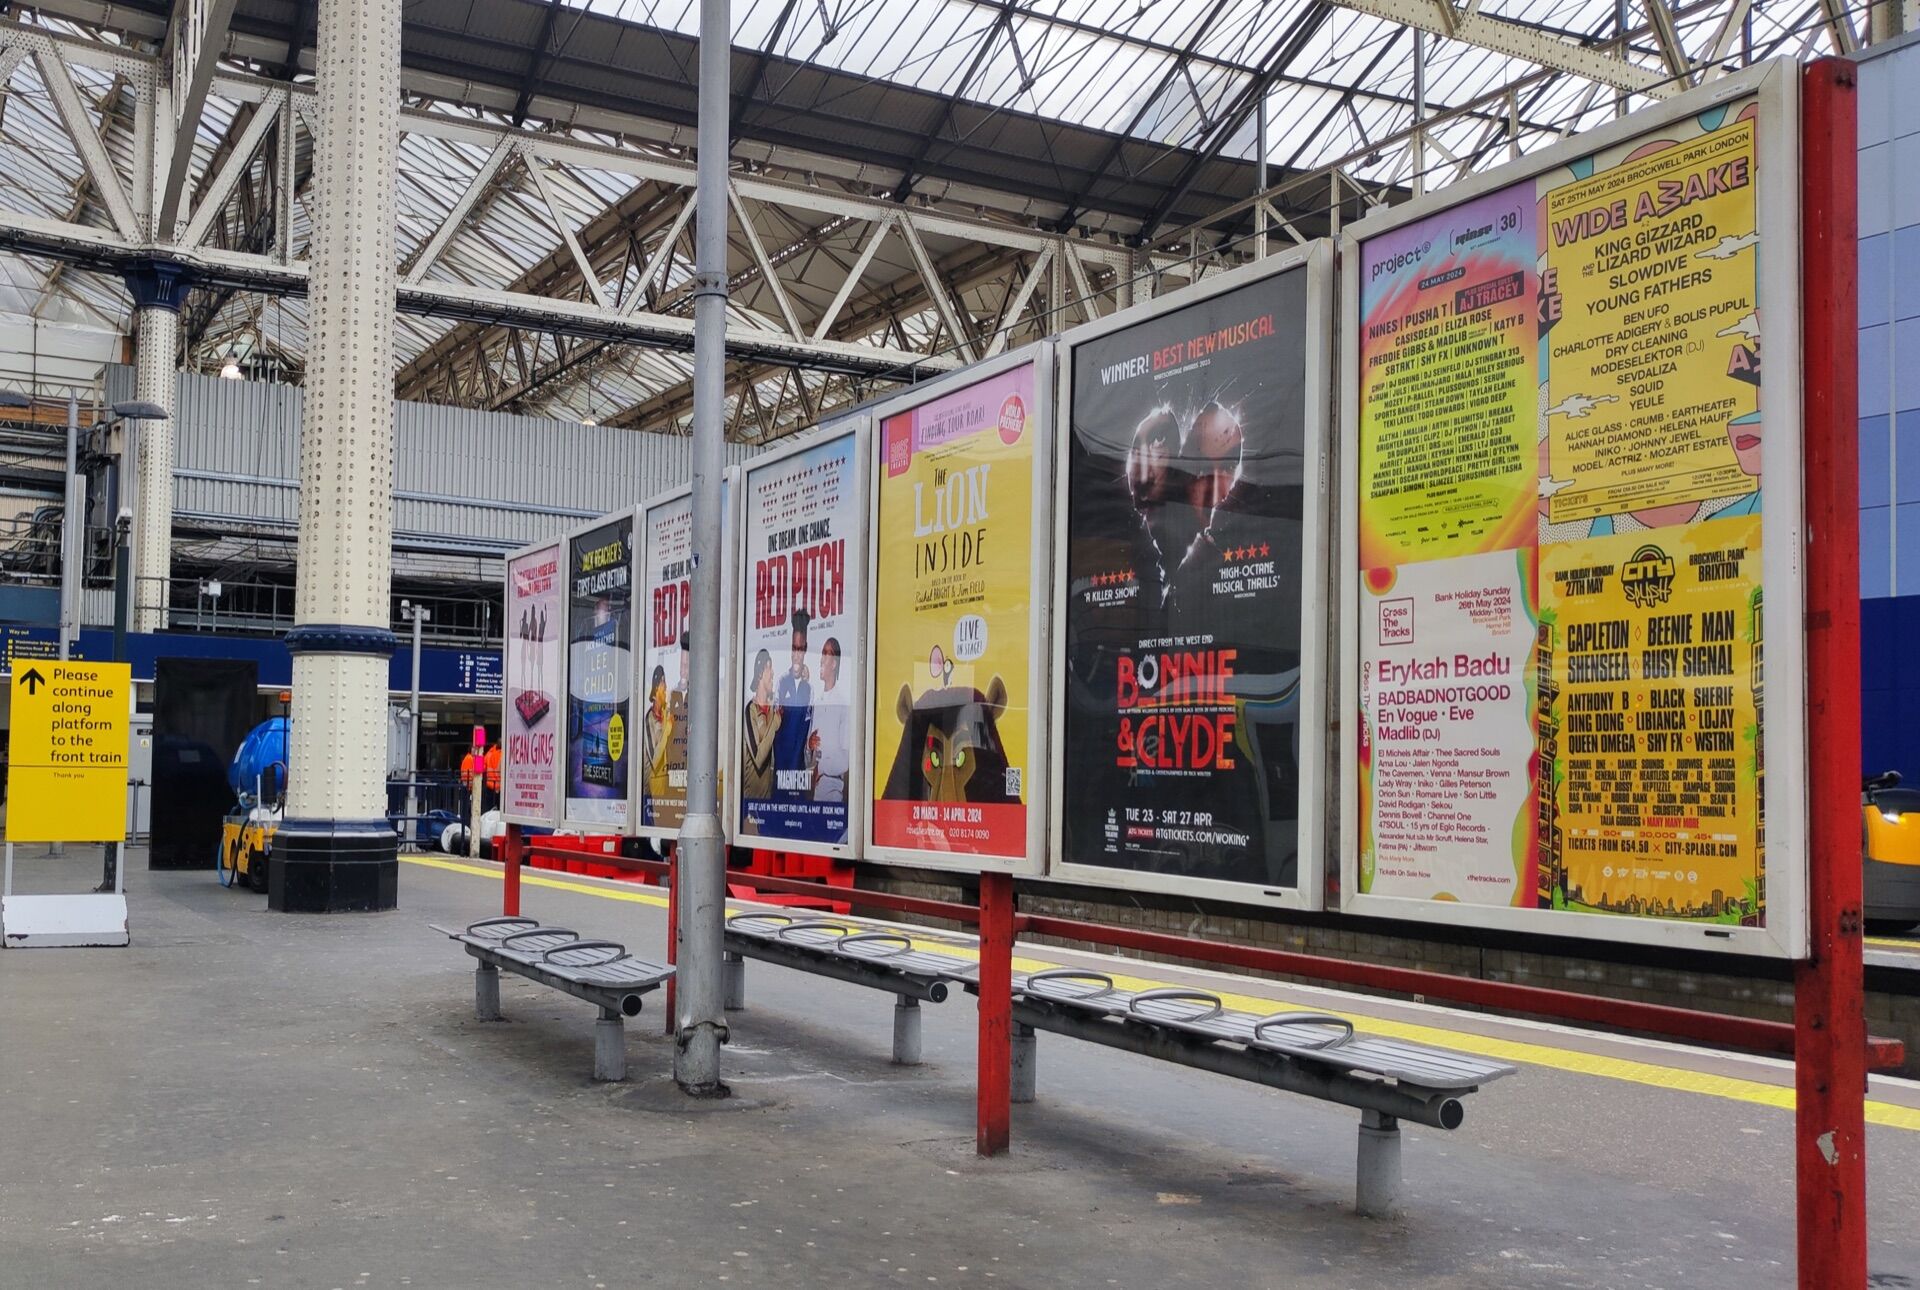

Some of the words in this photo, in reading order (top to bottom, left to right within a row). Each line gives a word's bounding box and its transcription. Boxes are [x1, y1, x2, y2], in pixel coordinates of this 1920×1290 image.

[1551, 199, 1566, 209] SAT
[1567, 192, 1587, 205] 25TH
[1588, 184, 1606, 198] MAY
[1607, 177, 1626, 190] 2024
[1627, 158, 1682, 186] BROCKWELL
[1683, 147, 1708, 164] PARK
[1709, 131, 1750, 153] LONDON
[1500, 212, 1517, 232] 30
[1551, 199, 1627, 248] WIDE
[1594, 236, 1631, 259] KING
[1635, 214, 1703, 245] GIZZARD
[1597, 246, 1650, 274] LIZARD
[1656, 225, 1717, 256] WIZARD
[1420, 280, 1430, 289] 24
[1431, 275, 1445, 286] MAY
[1446, 269, 1463, 282] 2024
[1609, 255, 1687, 290] SLOWDIVE
[1586, 289, 1640, 315] YOUNG
[1644, 268, 1712, 300] FATHERS
[1369, 320, 1398, 339] NINES
[1405, 307, 1439, 329] PUSHA
[1441, 304, 1448, 317] T
[1459, 295, 1473, 312] AJ
[1477, 281, 1519, 308] TRACEY
[1623, 310, 1645, 326] BEN
[1647, 304, 1670, 320] UFO
[1395, 325, 1439, 347] CASISDEAD
[1445, 315, 1468, 332] ELIZA
[1470, 309, 1492, 326] ROSE
[1553, 333, 1614, 358] CHARLOTTE
[1616, 320, 1662, 344] ADIGERY
[1674, 308, 1707, 328] BOLIS
[1709, 298, 1750, 317] PUPUL
[1101, 354, 1150, 386] WINNER!
[1153, 343, 1184, 370] BEST
[1188, 332, 1216, 360] NEW
[1218, 314, 1276, 350] MUSICAL
[1369, 351, 1401, 368] FREDDIE
[1402, 343, 1427, 358] GIBBS
[1428, 340, 1435, 350] &
[1436, 331, 1468, 349] MADLIB
[1494, 316, 1517, 332] KATY
[1518, 313, 1525, 325] B
[1605, 344, 1628, 359] DRY
[1631, 329, 1688, 351] CLEANING
[1385, 359, 1415, 376] SBTRKT
[1420, 353, 1436, 367] SHY
[1438, 350, 1449, 362] FX
[1454, 336, 1498, 358] UNKNOWN
[1500, 334, 1505, 345] T
[1591, 345, 1683, 377] MODESELEKTOR
[1617, 362, 1677, 385] SEVDALIZA
[1630, 380, 1664, 397] SQUID
[1005, 404, 1021, 418] WORLD
[1629, 393, 1665, 411] YEULE
[921, 423, 946, 444] FINDING
[947, 415, 964, 435] YOUR
[966, 405, 985, 426] ROAR!
[1000, 416, 1023, 433] PREMIERE
[934, 468, 947, 488] THE
[913, 463, 991, 537] LION
[767, 533, 778, 554] ONE
[798, 524, 809, 545] ONE
[809, 518, 832, 542] CHANCE.
[915, 528, 987, 579] INSIDE
[1622, 556, 1675, 583] CITY
[1698, 561, 1739, 583] BRIXTON
[577, 576, 590, 598] FIRST
[590, 571, 607, 594] CLASS
[606, 565, 628, 589] RETURN
[755, 555, 788, 630] RED
[791, 538, 845, 621] PITCH
[1212, 580, 1244, 595] MUSICAL
[1566, 578, 1585, 597] 27TH
[1586, 577, 1604, 594] MAY
[1092, 588, 1113, 602] KILLER
[1435, 593, 1453, 602] Bank
[1454, 589, 1482, 600] Holiday
[1482, 586, 1511, 597] Sunday
[1458, 600, 1475, 610] 26th
[1475, 598, 1492, 609] May
[1493, 596, 1511, 606] 2024
[1623, 578, 1672, 609] SPLASH
[653, 583, 678, 648] RED
[1383, 617, 1399, 628] The
[960, 619, 979, 641] LIVE
[1138, 639, 1157, 648] DIRECT
[1158, 637, 1173, 647] FROM
[1174, 636, 1185, 646] THE
[1186, 635, 1201, 645] WEST
[1201, 634, 1213, 644] END
[1383, 627, 1410, 638] Tracks
[1567, 619, 1630, 653] CAPLETON
[1647, 613, 1693, 647] BEENIE
[1701, 610, 1735, 643] MAN
[591, 651, 608, 672] LEE
[1378, 656, 1448, 687] Erykah
[1454, 652, 1510, 678] Badu
[1567, 651, 1630, 684] SHENSEEA
[1642, 647, 1679, 680] BUSY
[1683, 644, 1734, 677] SIGNAL
[54, 668, 98, 682] Please
[584, 671, 614, 696] CHILD
[1117, 648, 1237, 708] BONNIE
[53, 686, 114, 698] continue
[1378, 684, 1511, 706] BADBADNOTGOOD
[52, 701, 92, 717] along
[1378, 708, 1394, 723] En
[1397, 706, 1438, 726] Vogue
[1449, 706, 1475, 721] Eve
[52, 718, 112, 732] platform
[1378, 725, 1420, 740] Madlib
[1422, 727, 1441, 742] (DJ)
[51, 735, 66, 746] to
[70, 735, 93, 746] the
[509, 733, 530, 766] MEAN
[530, 732, 554, 767] GIRLS
[1117, 717, 1135, 752] &
[1137, 713, 1237, 769] CLYDE
[51, 750, 85, 763] front
[89, 751, 122, 763] train
[583, 764, 593, 779] THE
[920, 806, 939, 820] MARCH
[943, 807, 950, 821] 14
[950, 807, 967, 822] APRIL
[967, 808, 982, 823] 2024
[1125, 807, 1140, 821] TUE
[1142, 808, 1154, 822] 23
[1162, 810, 1177, 824] SAT
[1179, 811, 1191, 825] 27
[1194, 812, 1212, 827] APR
[949, 827, 960, 838] 020
[960, 828, 974, 839] 8174
[975, 829, 990, 840] 0090
[1568, 837, 1596, 851] TICKETS
[1599, 838, 1618, 852] FROM
[1665, 841, 1738, 858] CITY-SPLASH.COM
